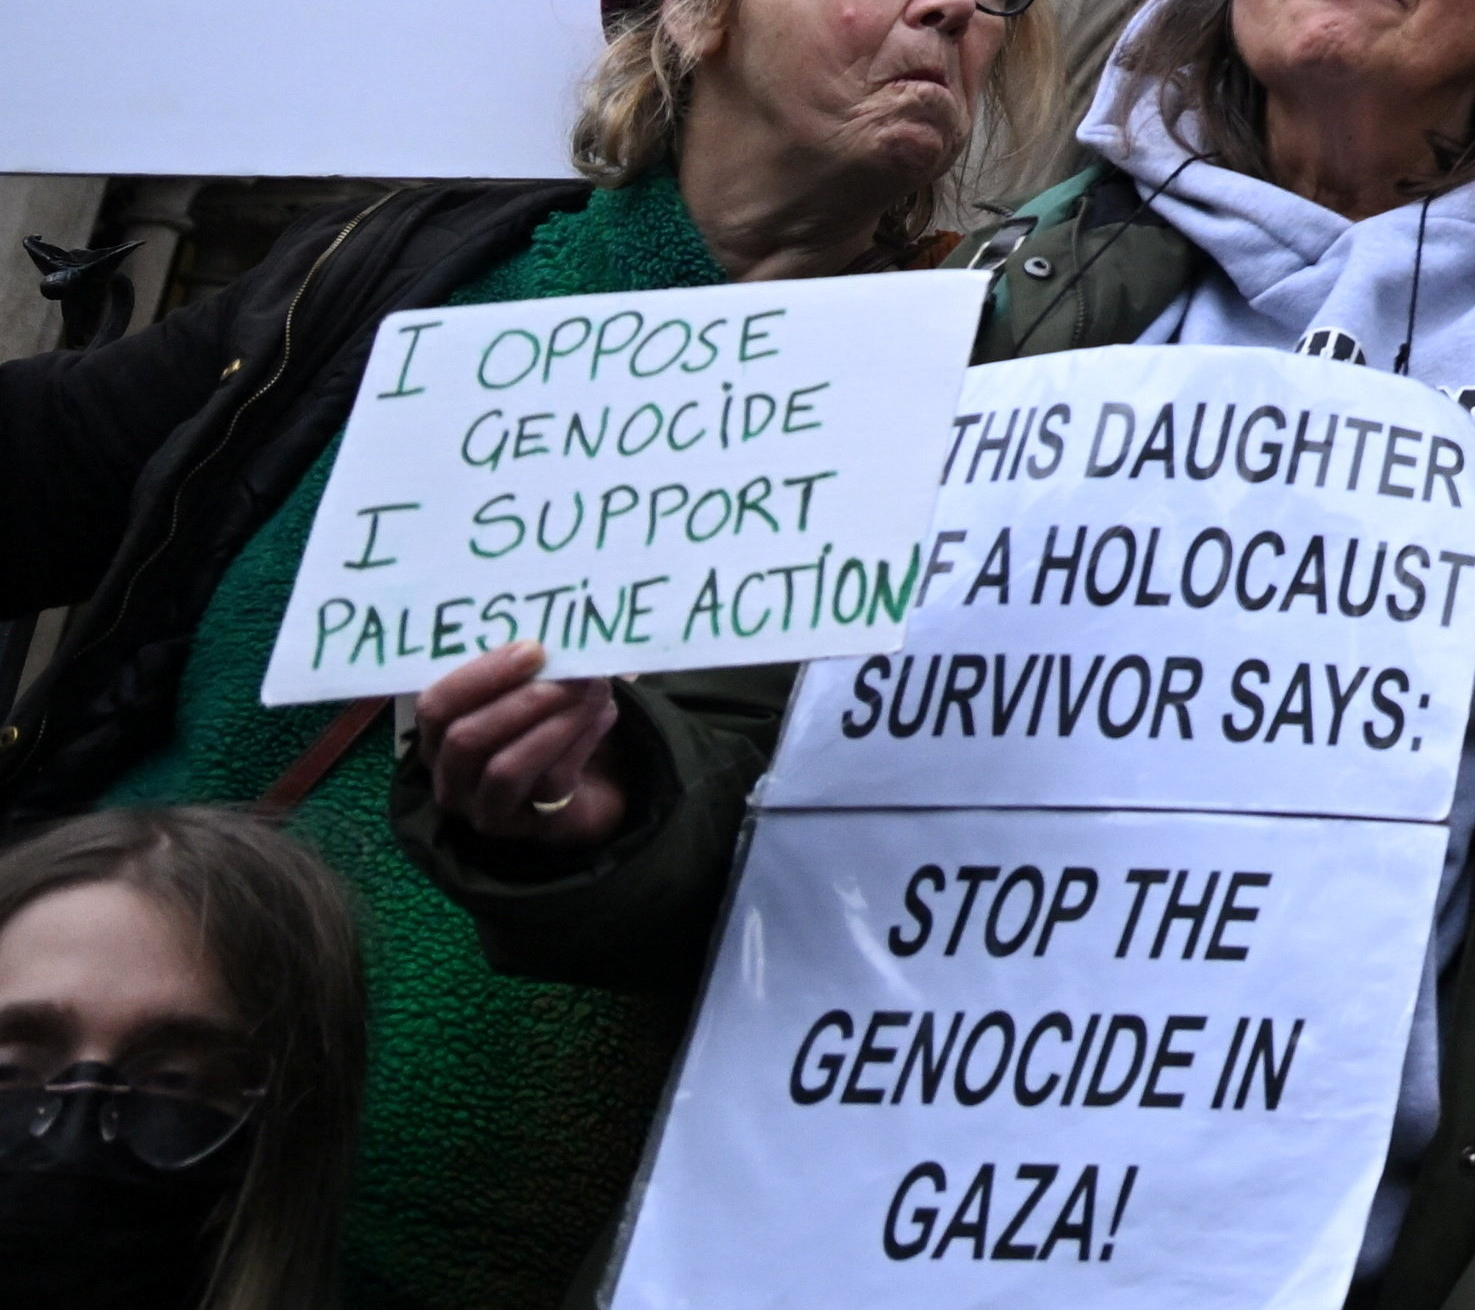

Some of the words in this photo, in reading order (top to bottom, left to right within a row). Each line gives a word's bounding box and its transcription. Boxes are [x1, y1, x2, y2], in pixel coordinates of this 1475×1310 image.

[377, 322, 442, 399] I
[478, 309, 786, 388] OPPOSE
[940, 403, 1066, 486] THIS
[1085, 401, 1466, 508] DAUGHTER
[344, 503, 421, 569] I
[469, 471, 838, 558] SUPPORT
[965, 526, 1011, 607] A
[1029, 525, 1475, 628] HOLOCAUST
[840, 654, 1202, 741] SURVIVOR
[1221, 658, 1431, 754] SAYS:
[888, 864, 1098, 958] STOP
[1117, 868, 1272, 962] THE
[788, 1009, 1208, 1109] GENOCIDE
[1211, 1015, 1304, 1111] IN
[881, 1161, 1139, 1263] GAZA!
